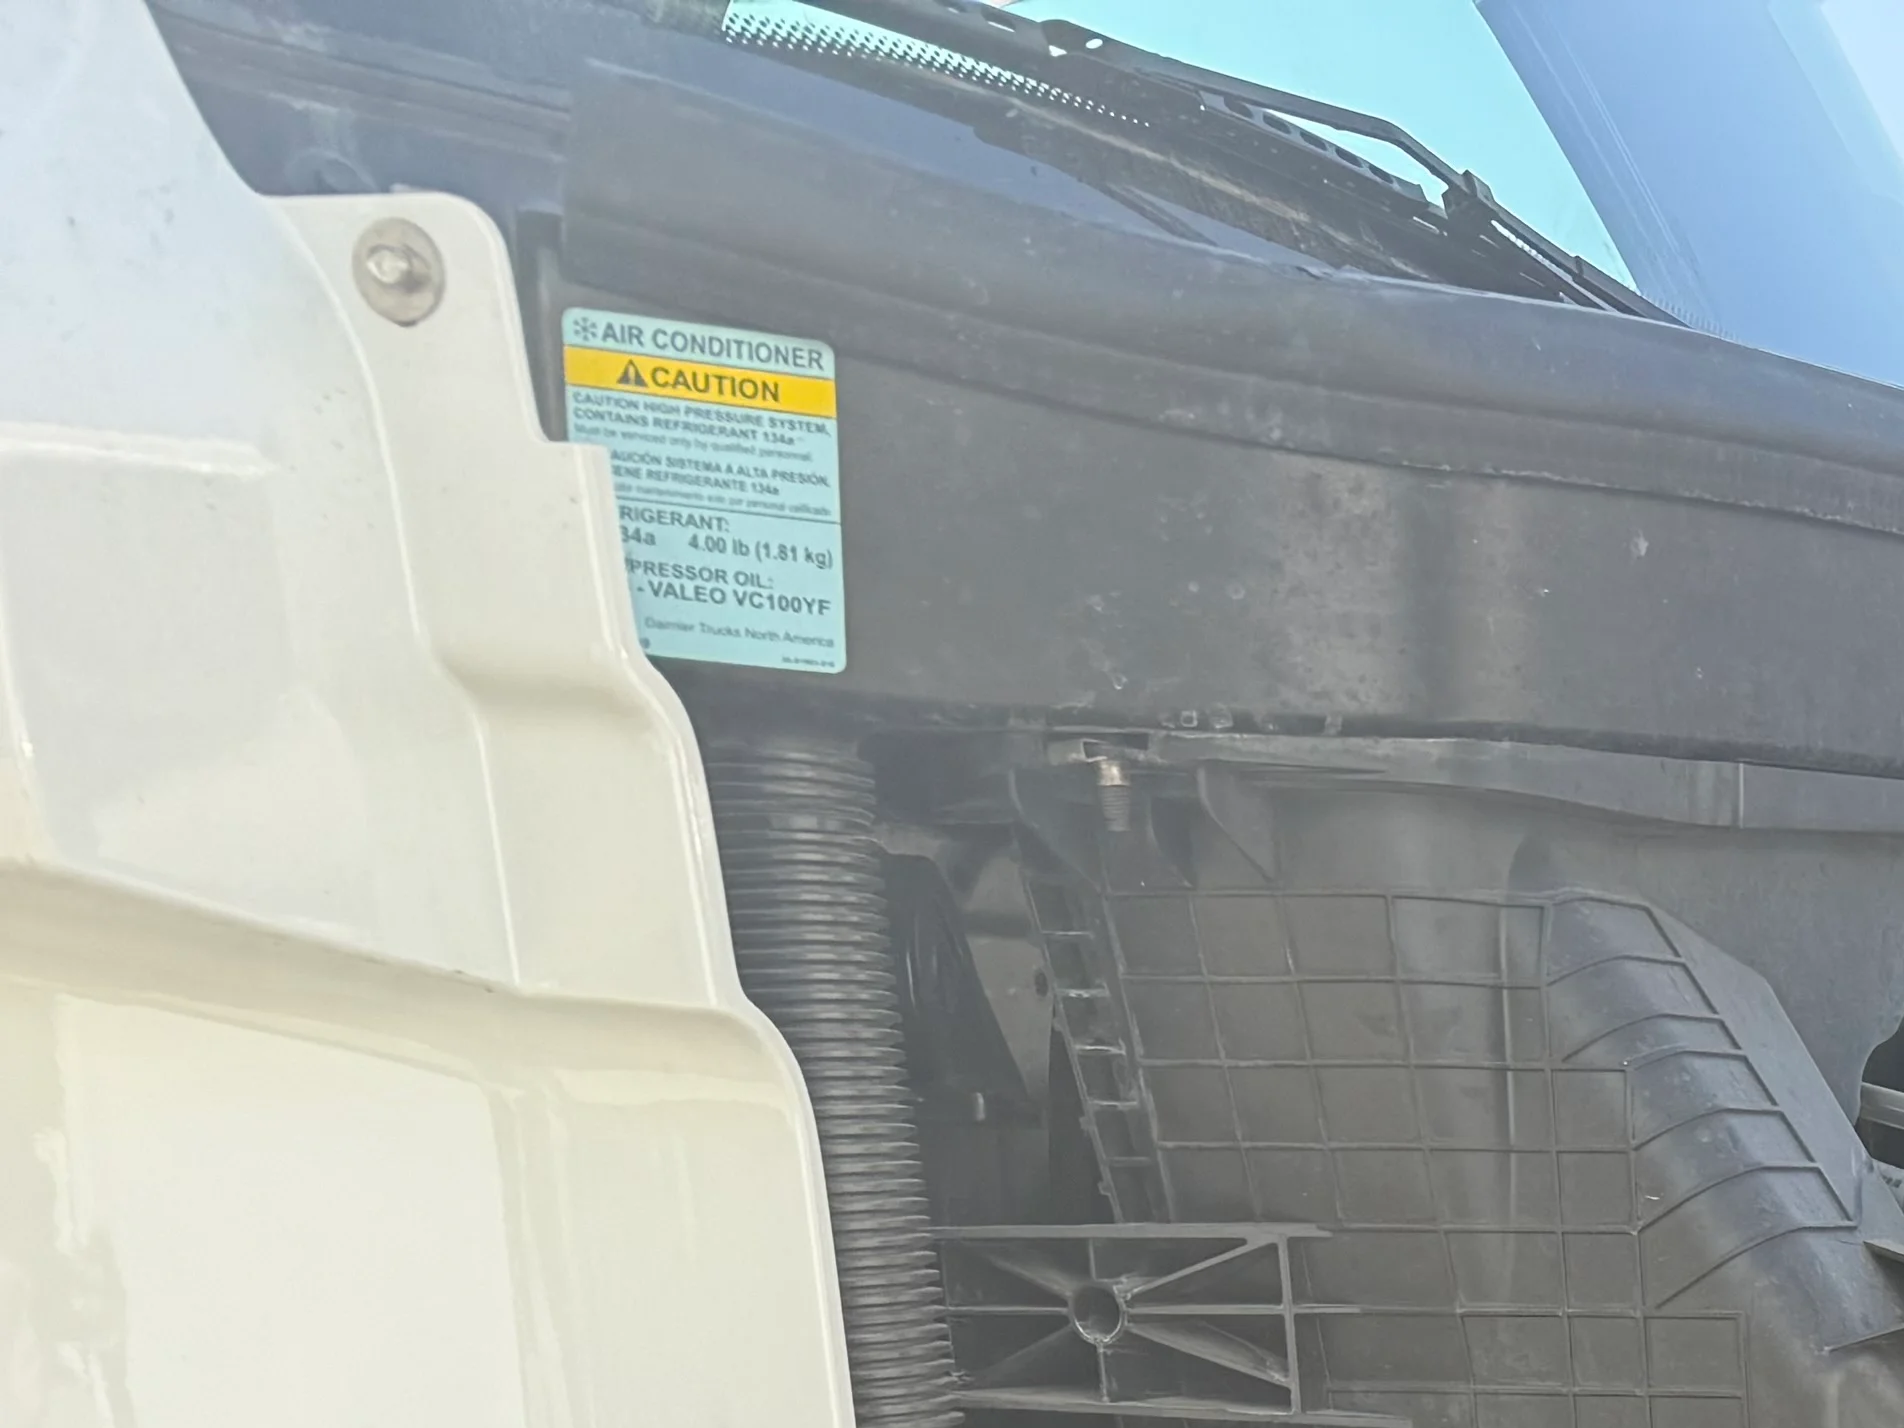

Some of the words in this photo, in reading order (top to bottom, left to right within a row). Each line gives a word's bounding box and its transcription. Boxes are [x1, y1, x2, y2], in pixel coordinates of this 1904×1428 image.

[601, 322, 644, 347] AIR
[651, 329, 824, 371] CONDITIONER
[650, 366, 780, 402] CAUTION
[573, 391, 640, 411] CAUTION
[643, 400, 680, 415] HIGH
[684, 404, 763, 427] PRESSURE
[573, 406, 649, 427] CONTAINS
[652, 415, 757, 439] REFRIGERANT
[646, 468, 748, 492] REFRIGERANTE
[666, 455, 722, 473] SISTEMA
[737, 464, 768, 479] ALTA
[619, 505, 730, 533] RIGERANT:
[620, 525, 656, 546] 34a
[688, 533, 727, 554] 4.00
[732, 539, 750, 557] lb
[804, 547, 834, 570] kg)
[627, 558, 729, 585] PRESSOR
[648, 580, 726, 605] VALEO
[733, 589, 832, 616] VC100YF
[645, 617, 695, 633] Daimler
[699, 622, 741, 638] Trucks
[745, 629, 780, 643] North
[781, 631, 835, 649] America
